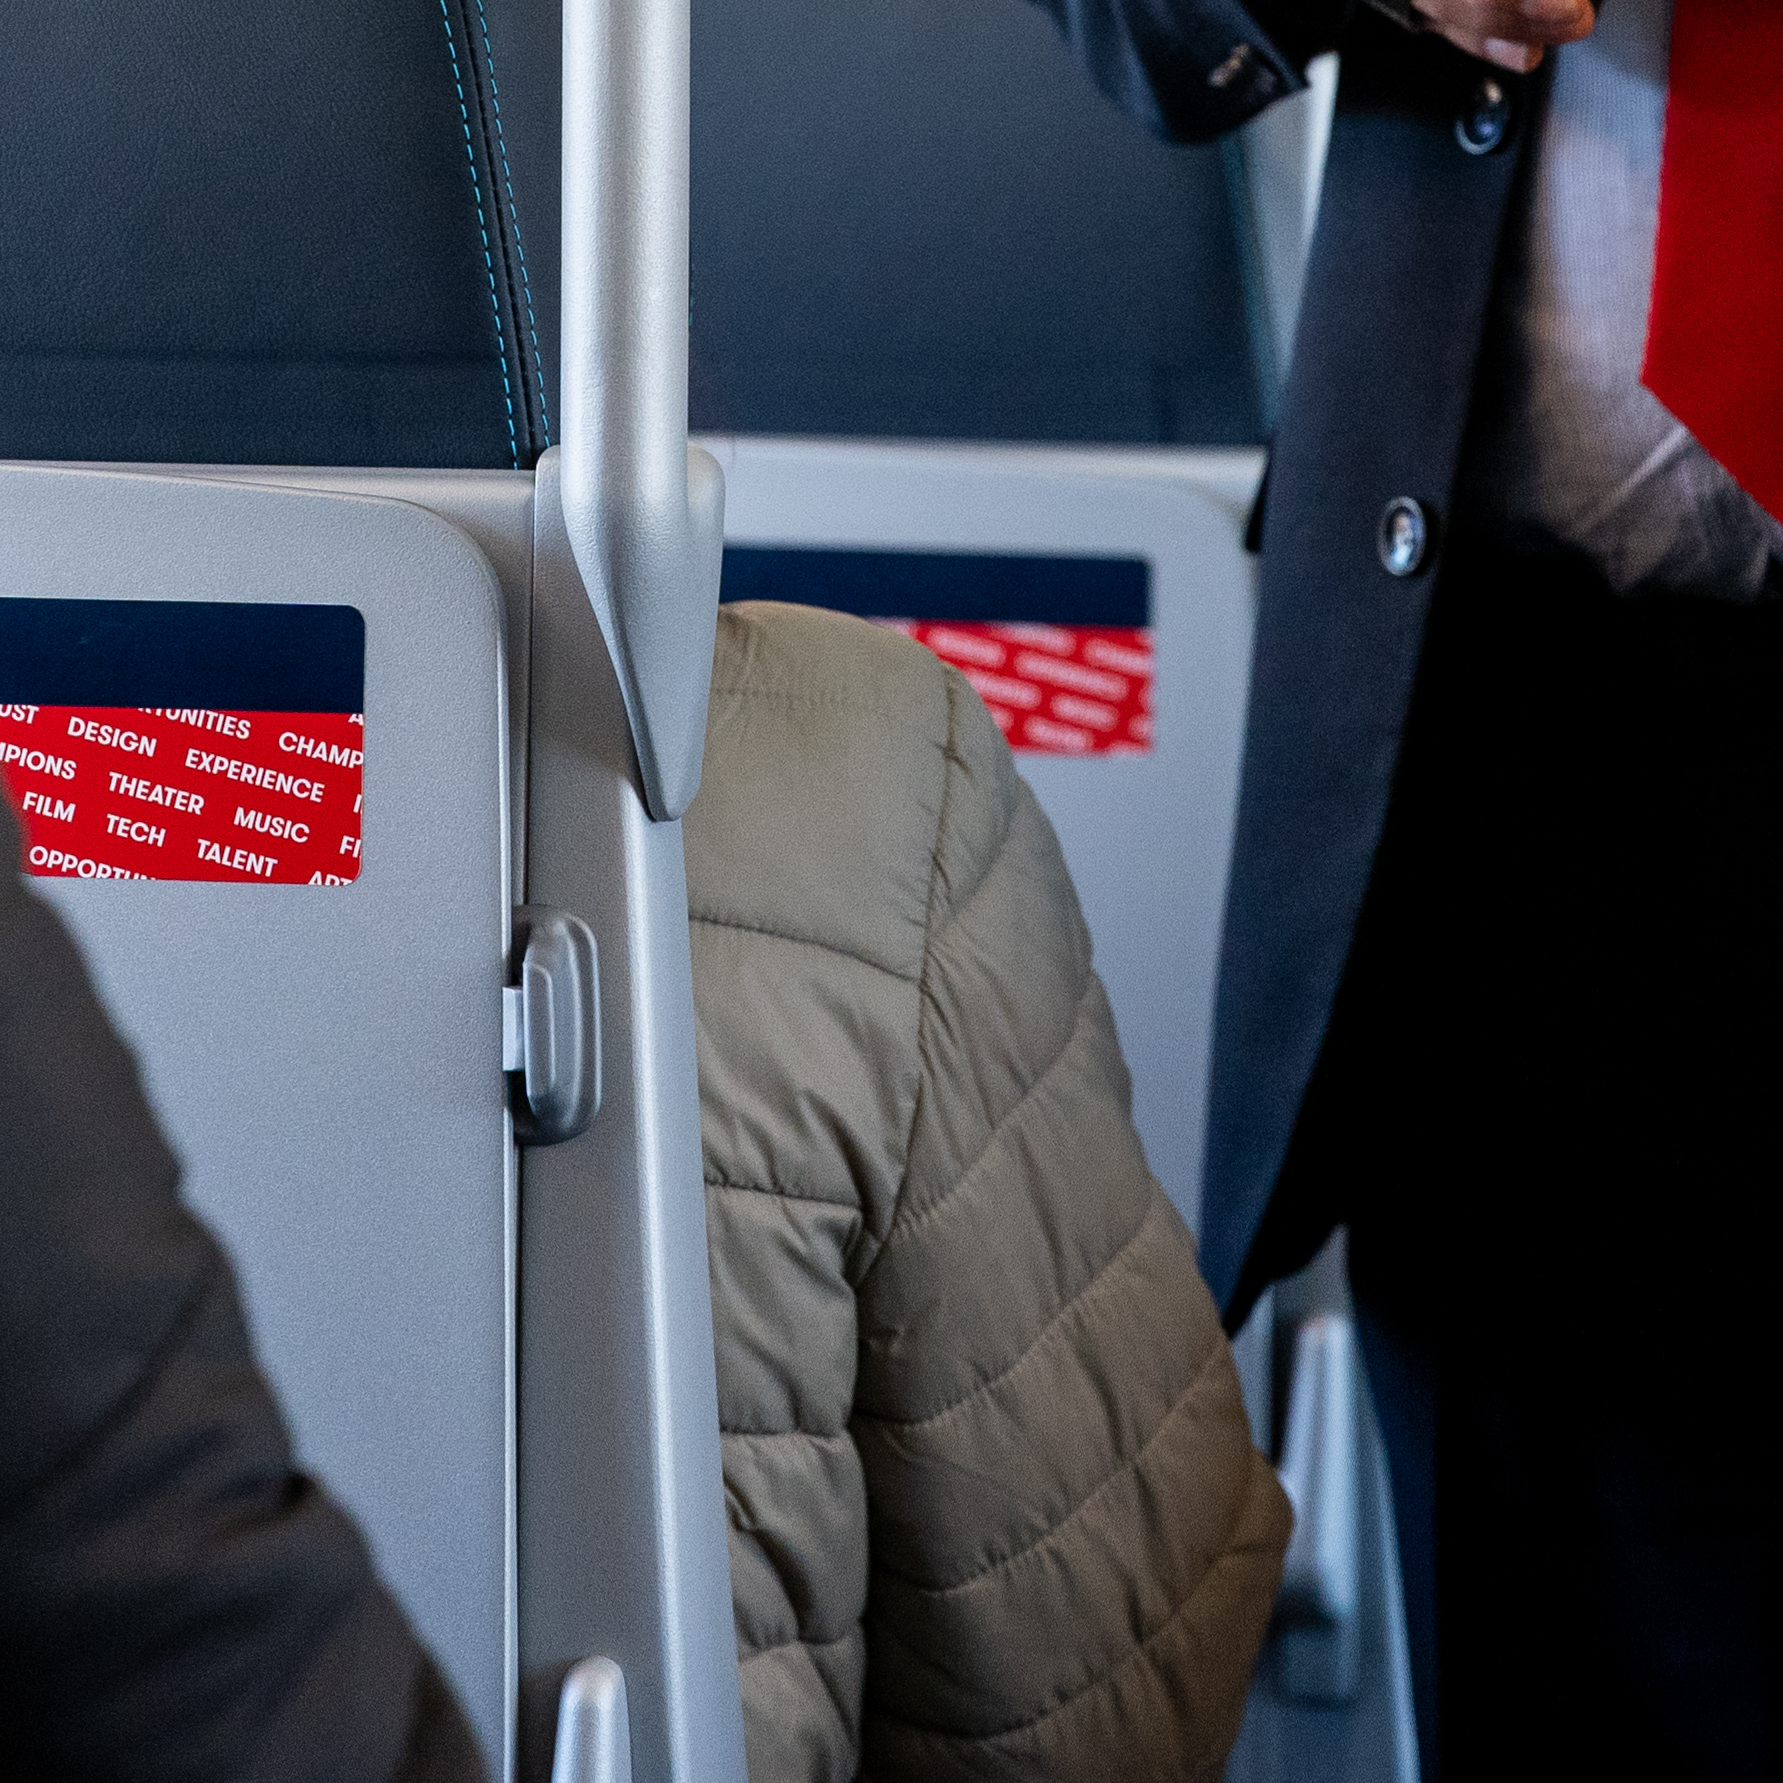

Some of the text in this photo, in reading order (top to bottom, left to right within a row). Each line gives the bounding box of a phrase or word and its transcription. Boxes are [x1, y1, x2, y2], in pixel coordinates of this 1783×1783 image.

[67, 716, 158, 758] DESIGN
[184, 747, 326, 803] EXPERIENCE
[22, 790, 77, 823] FILM
[106, 813, 167, 848] TECH
[196, 837, 279, 878] TALENT
[108, 771, 206, 816] THEATER
[233, 806, 311, 844] MUSIC
